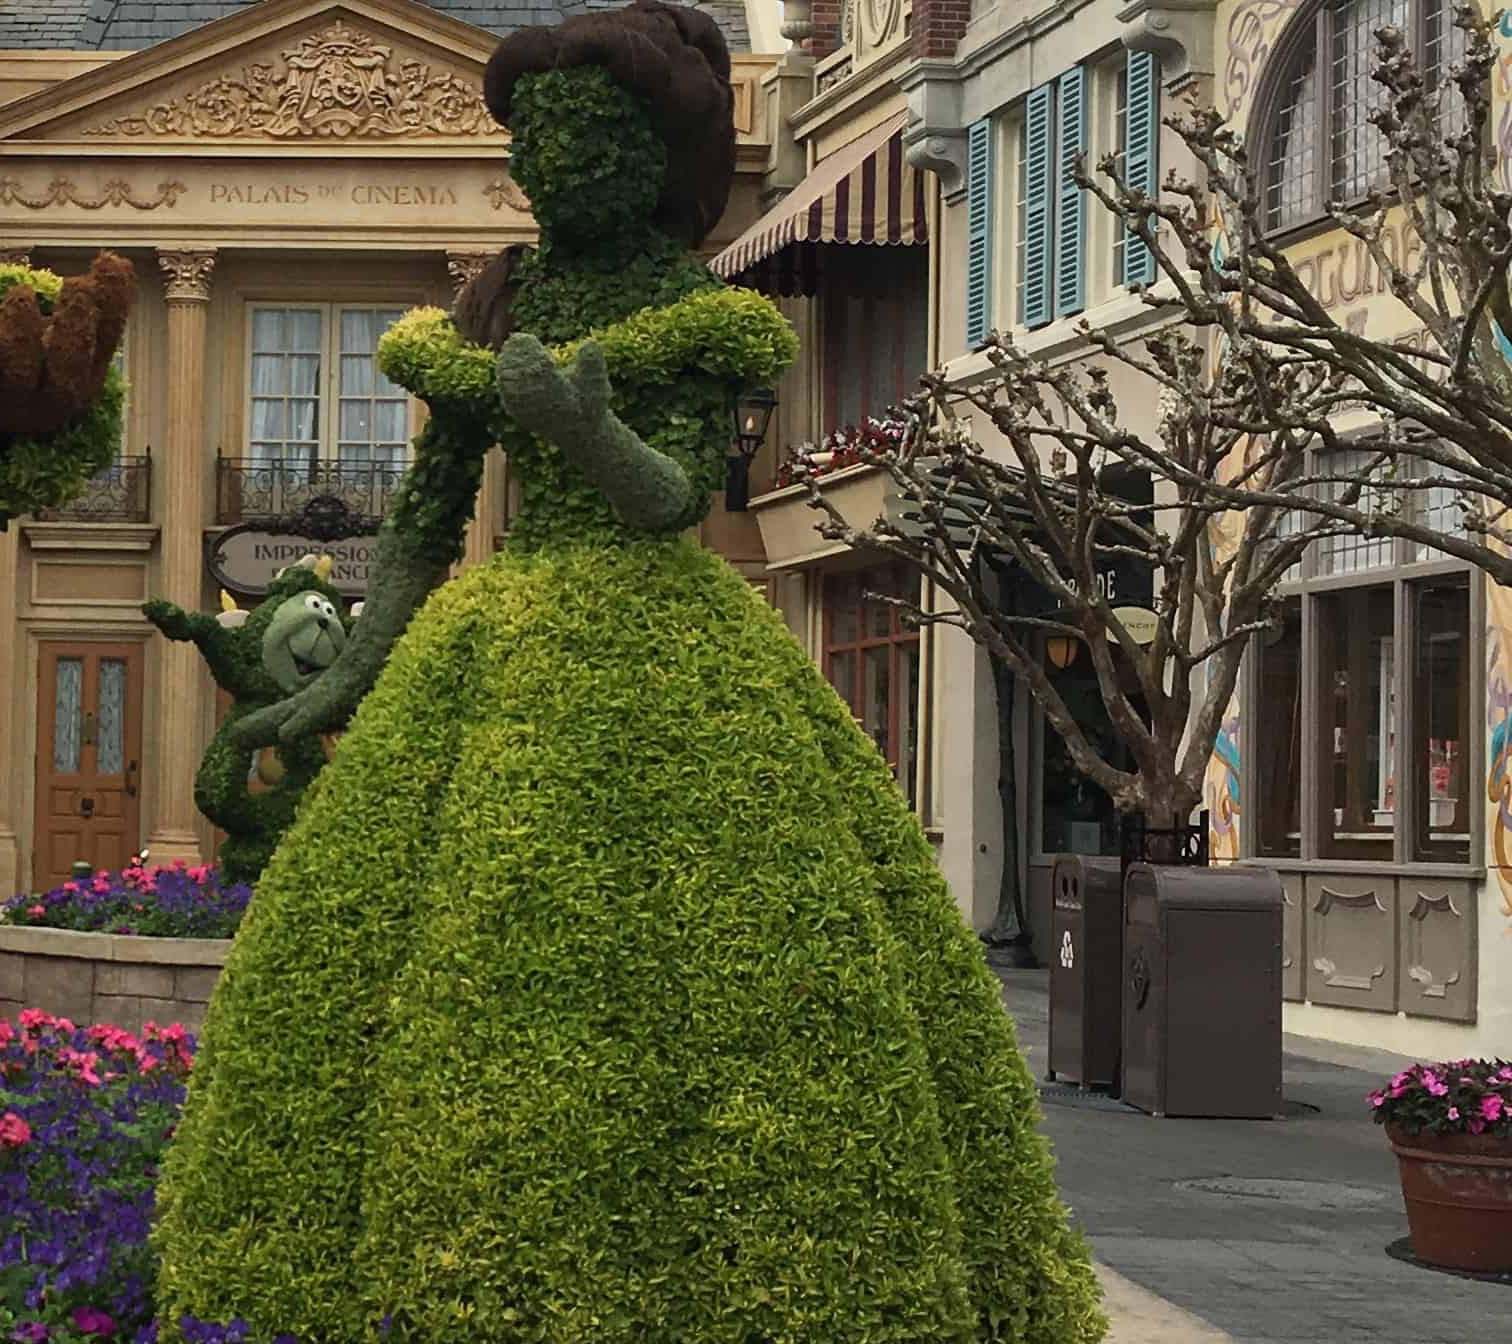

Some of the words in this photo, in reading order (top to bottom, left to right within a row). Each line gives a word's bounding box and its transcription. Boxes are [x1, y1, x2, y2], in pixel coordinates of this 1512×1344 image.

[209, 183, 309, 204] PALAIS
[350, 184, 458, 205] CINEMA
[254, 543, 376, 562] IMPRESSIO
